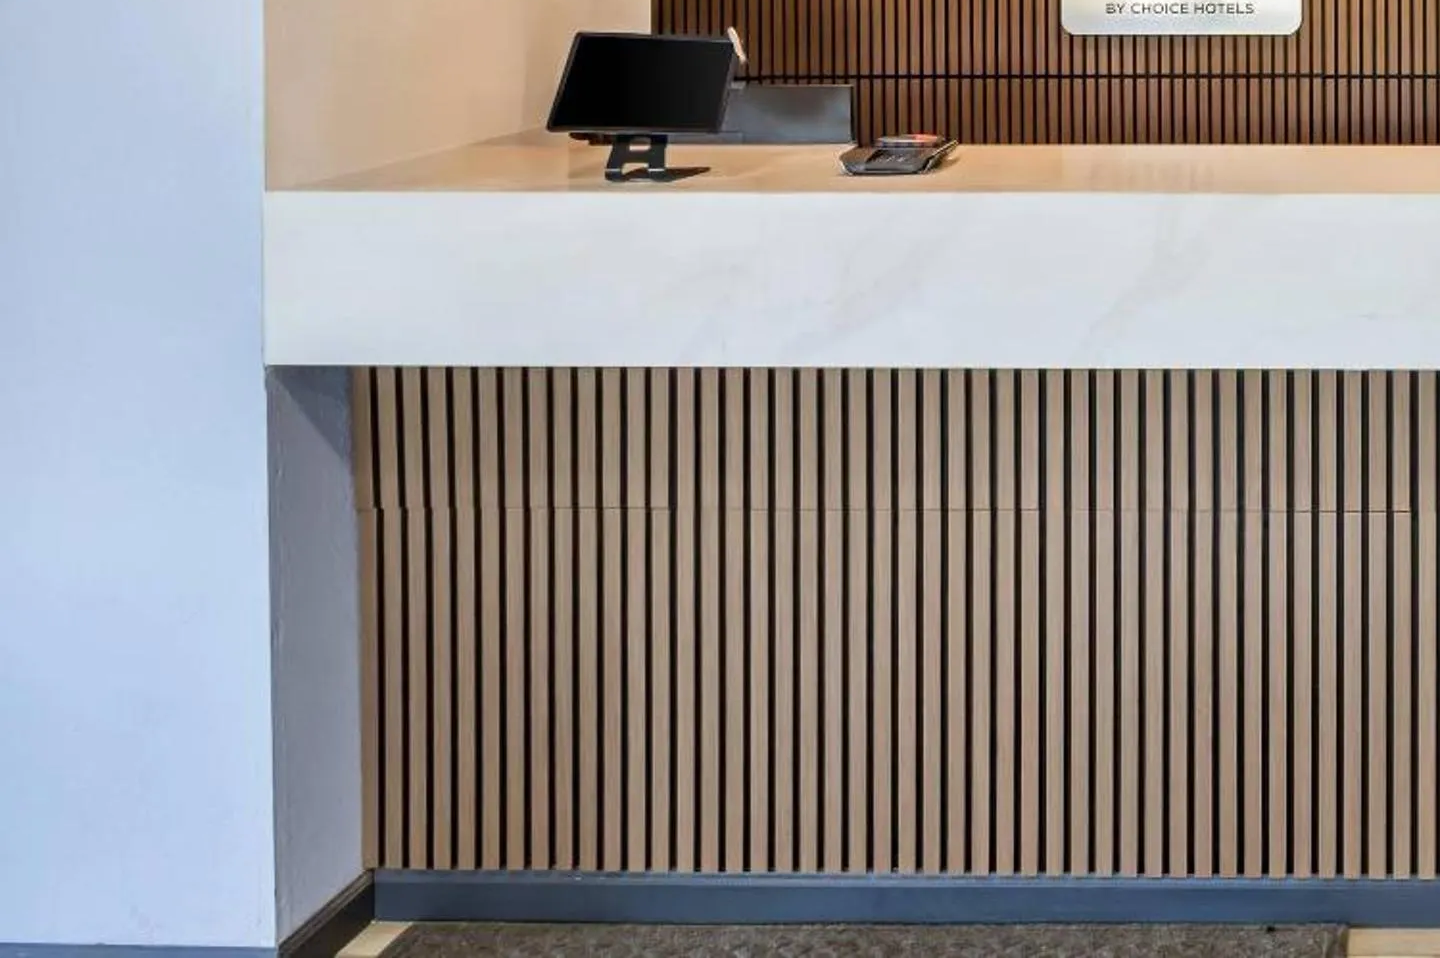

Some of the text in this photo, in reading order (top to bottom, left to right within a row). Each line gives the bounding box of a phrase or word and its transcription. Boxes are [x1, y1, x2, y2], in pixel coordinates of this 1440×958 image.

[1105, 2, 1255, 15] BY CHOICE HOTELS
